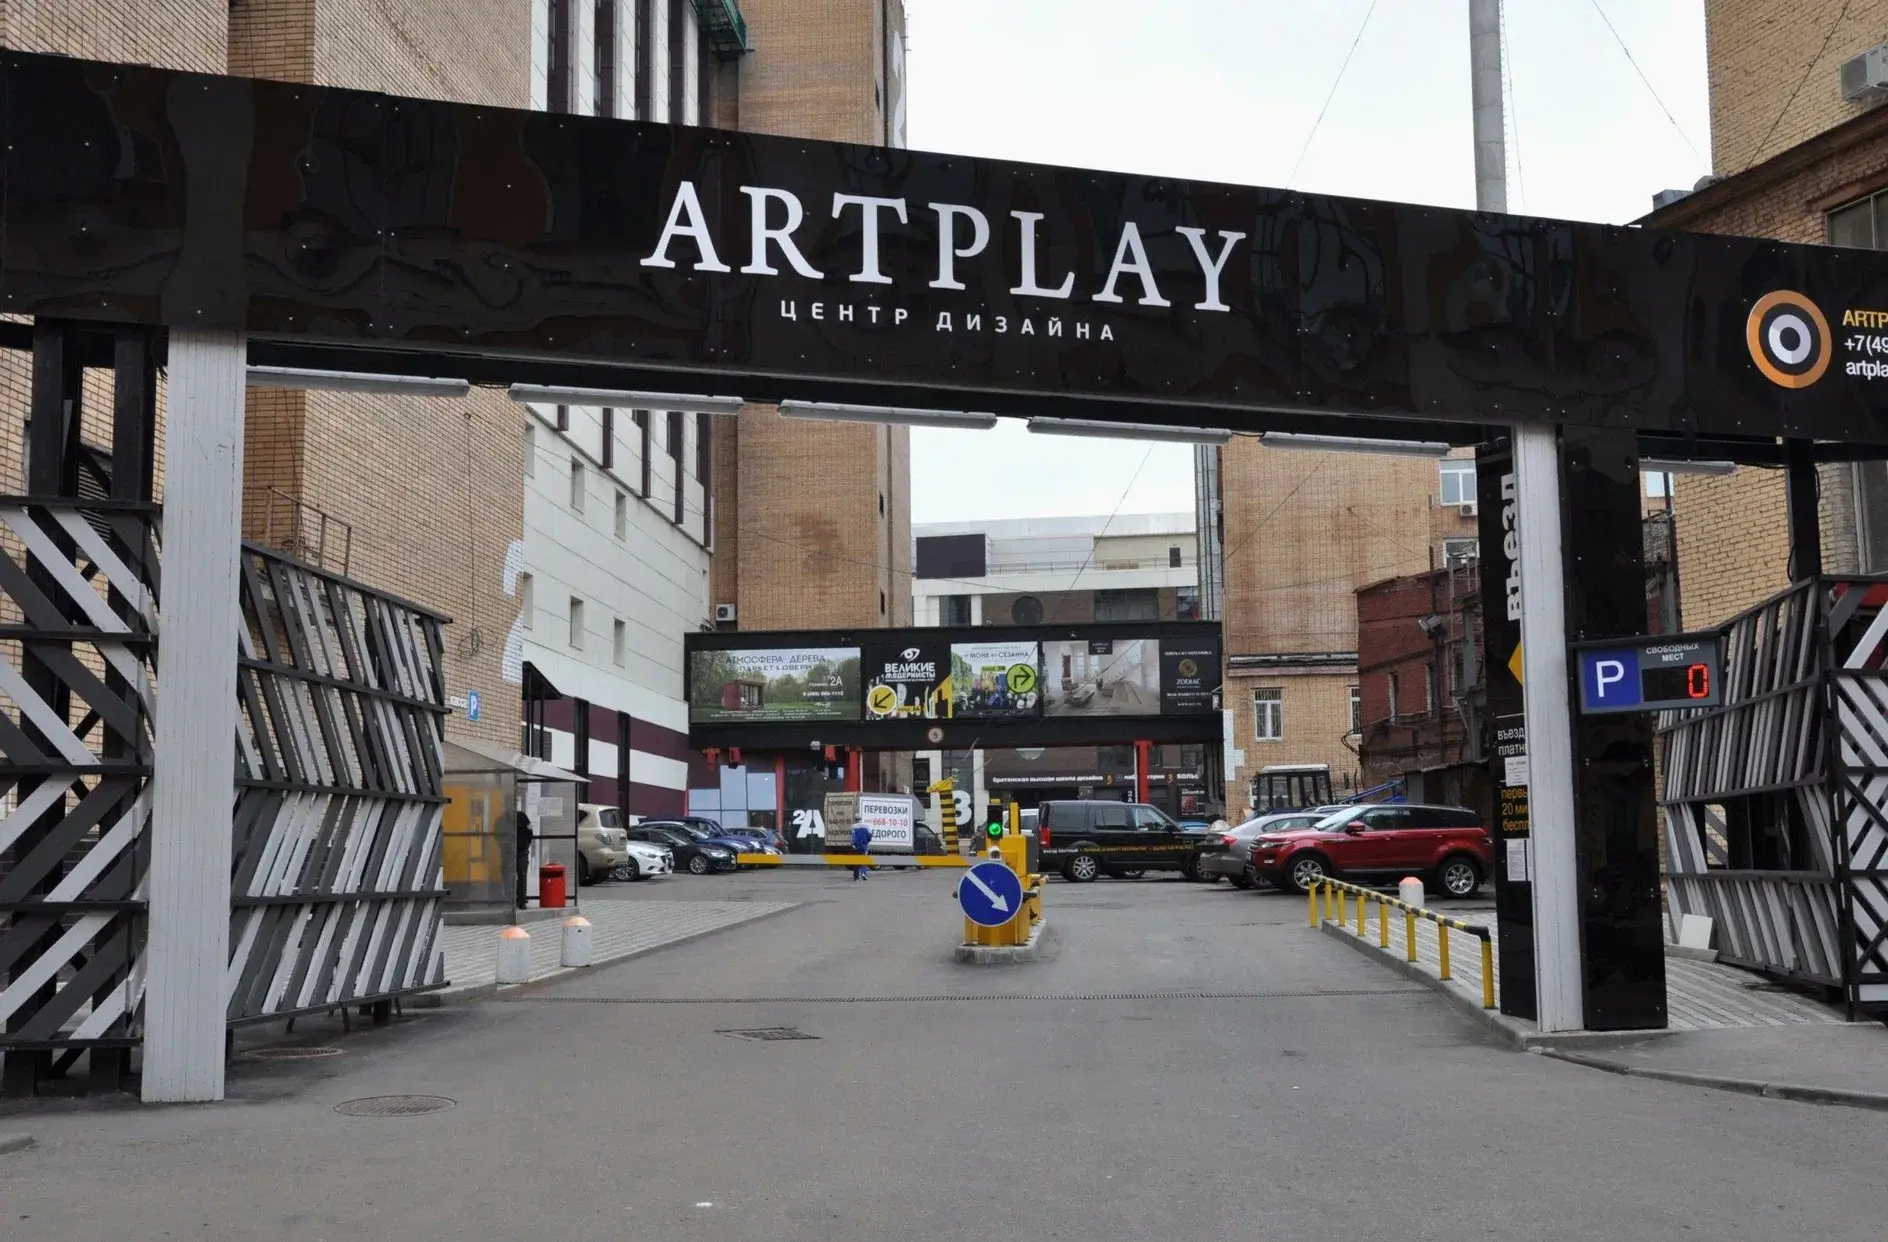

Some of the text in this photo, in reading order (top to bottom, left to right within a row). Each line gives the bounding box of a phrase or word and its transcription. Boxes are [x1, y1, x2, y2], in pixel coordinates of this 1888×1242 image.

[640, 181, 1246, 312] ARTPLAY
[781, 299, 1115, 341] ЦЕНТР ДИЗАЙНА
[1842, 309, 1888, 329] ARTP
[1646, 642, 1699, 654] СВОБОДНЫХ
[726, 654, 826, 664] АТМОСФЕРА ДЕРЕВА
[970, 651, 990, 659] МОНЕ
[998, 650, 1029, 659] СЕЗАННА
[1661, 653, 1684, 661] МЕСТ
[885, 662, 936, 673] ВЕЛИКИЕ
[1596, 660, 1624, 697] P
[1688, 664, 1708, 698] 0
[471, 695, 477, 715] P
[1077, 774, 1104, 782] дизайна
[864, 804, 908, 814] ПЕРЕВОЗКИ
[1502, 802, 1513, 815] 20
[873, 817, 908, 827] 668-10-10
[871, 829, 907, 838] ЕДОРОГО
